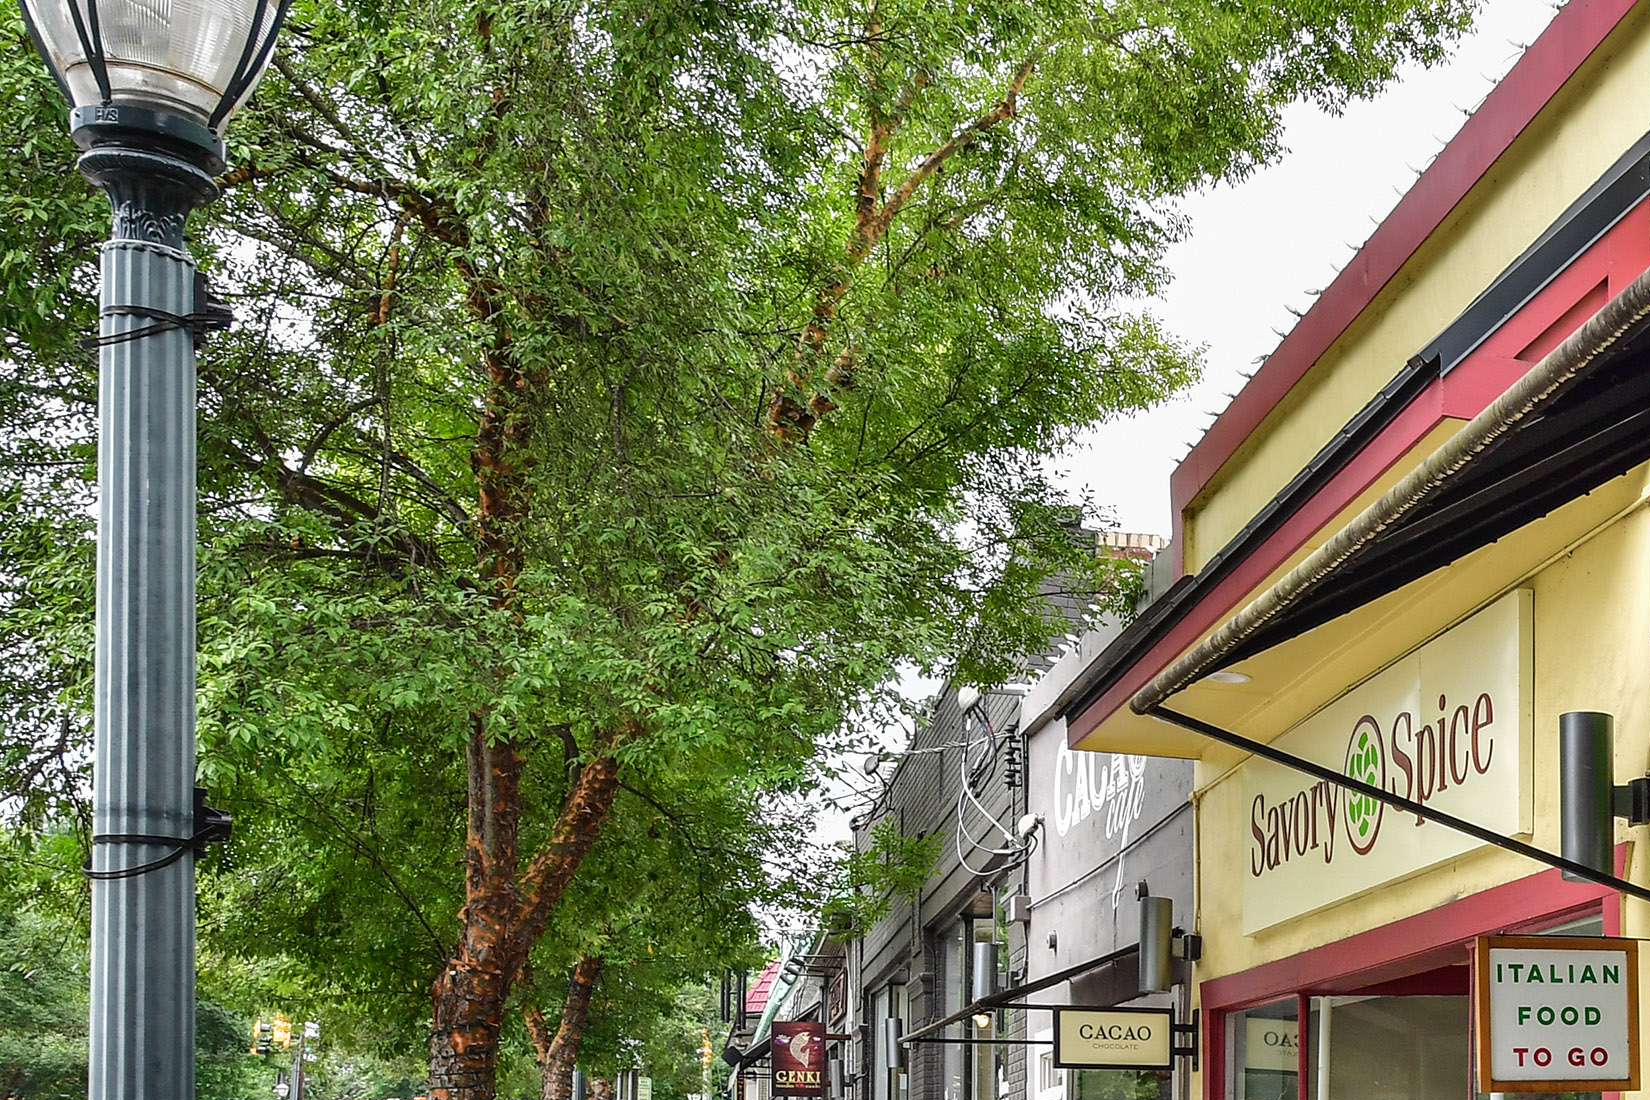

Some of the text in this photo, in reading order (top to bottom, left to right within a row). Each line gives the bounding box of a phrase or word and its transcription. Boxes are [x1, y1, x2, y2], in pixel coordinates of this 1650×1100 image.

[1054, 739, 1147, 837] CACA
[1251, 693, 1494, 877] Savory Spice
[1496, 963, 1619, 984] ITALIAN
[1517, 1006, 1602, 1026] FOOD
[1079, 1024, 1152, 1041] CACAO
[1512, 1047, 1609, 1067] TO GO
[775, 1070, 822, 1082] GENKI
